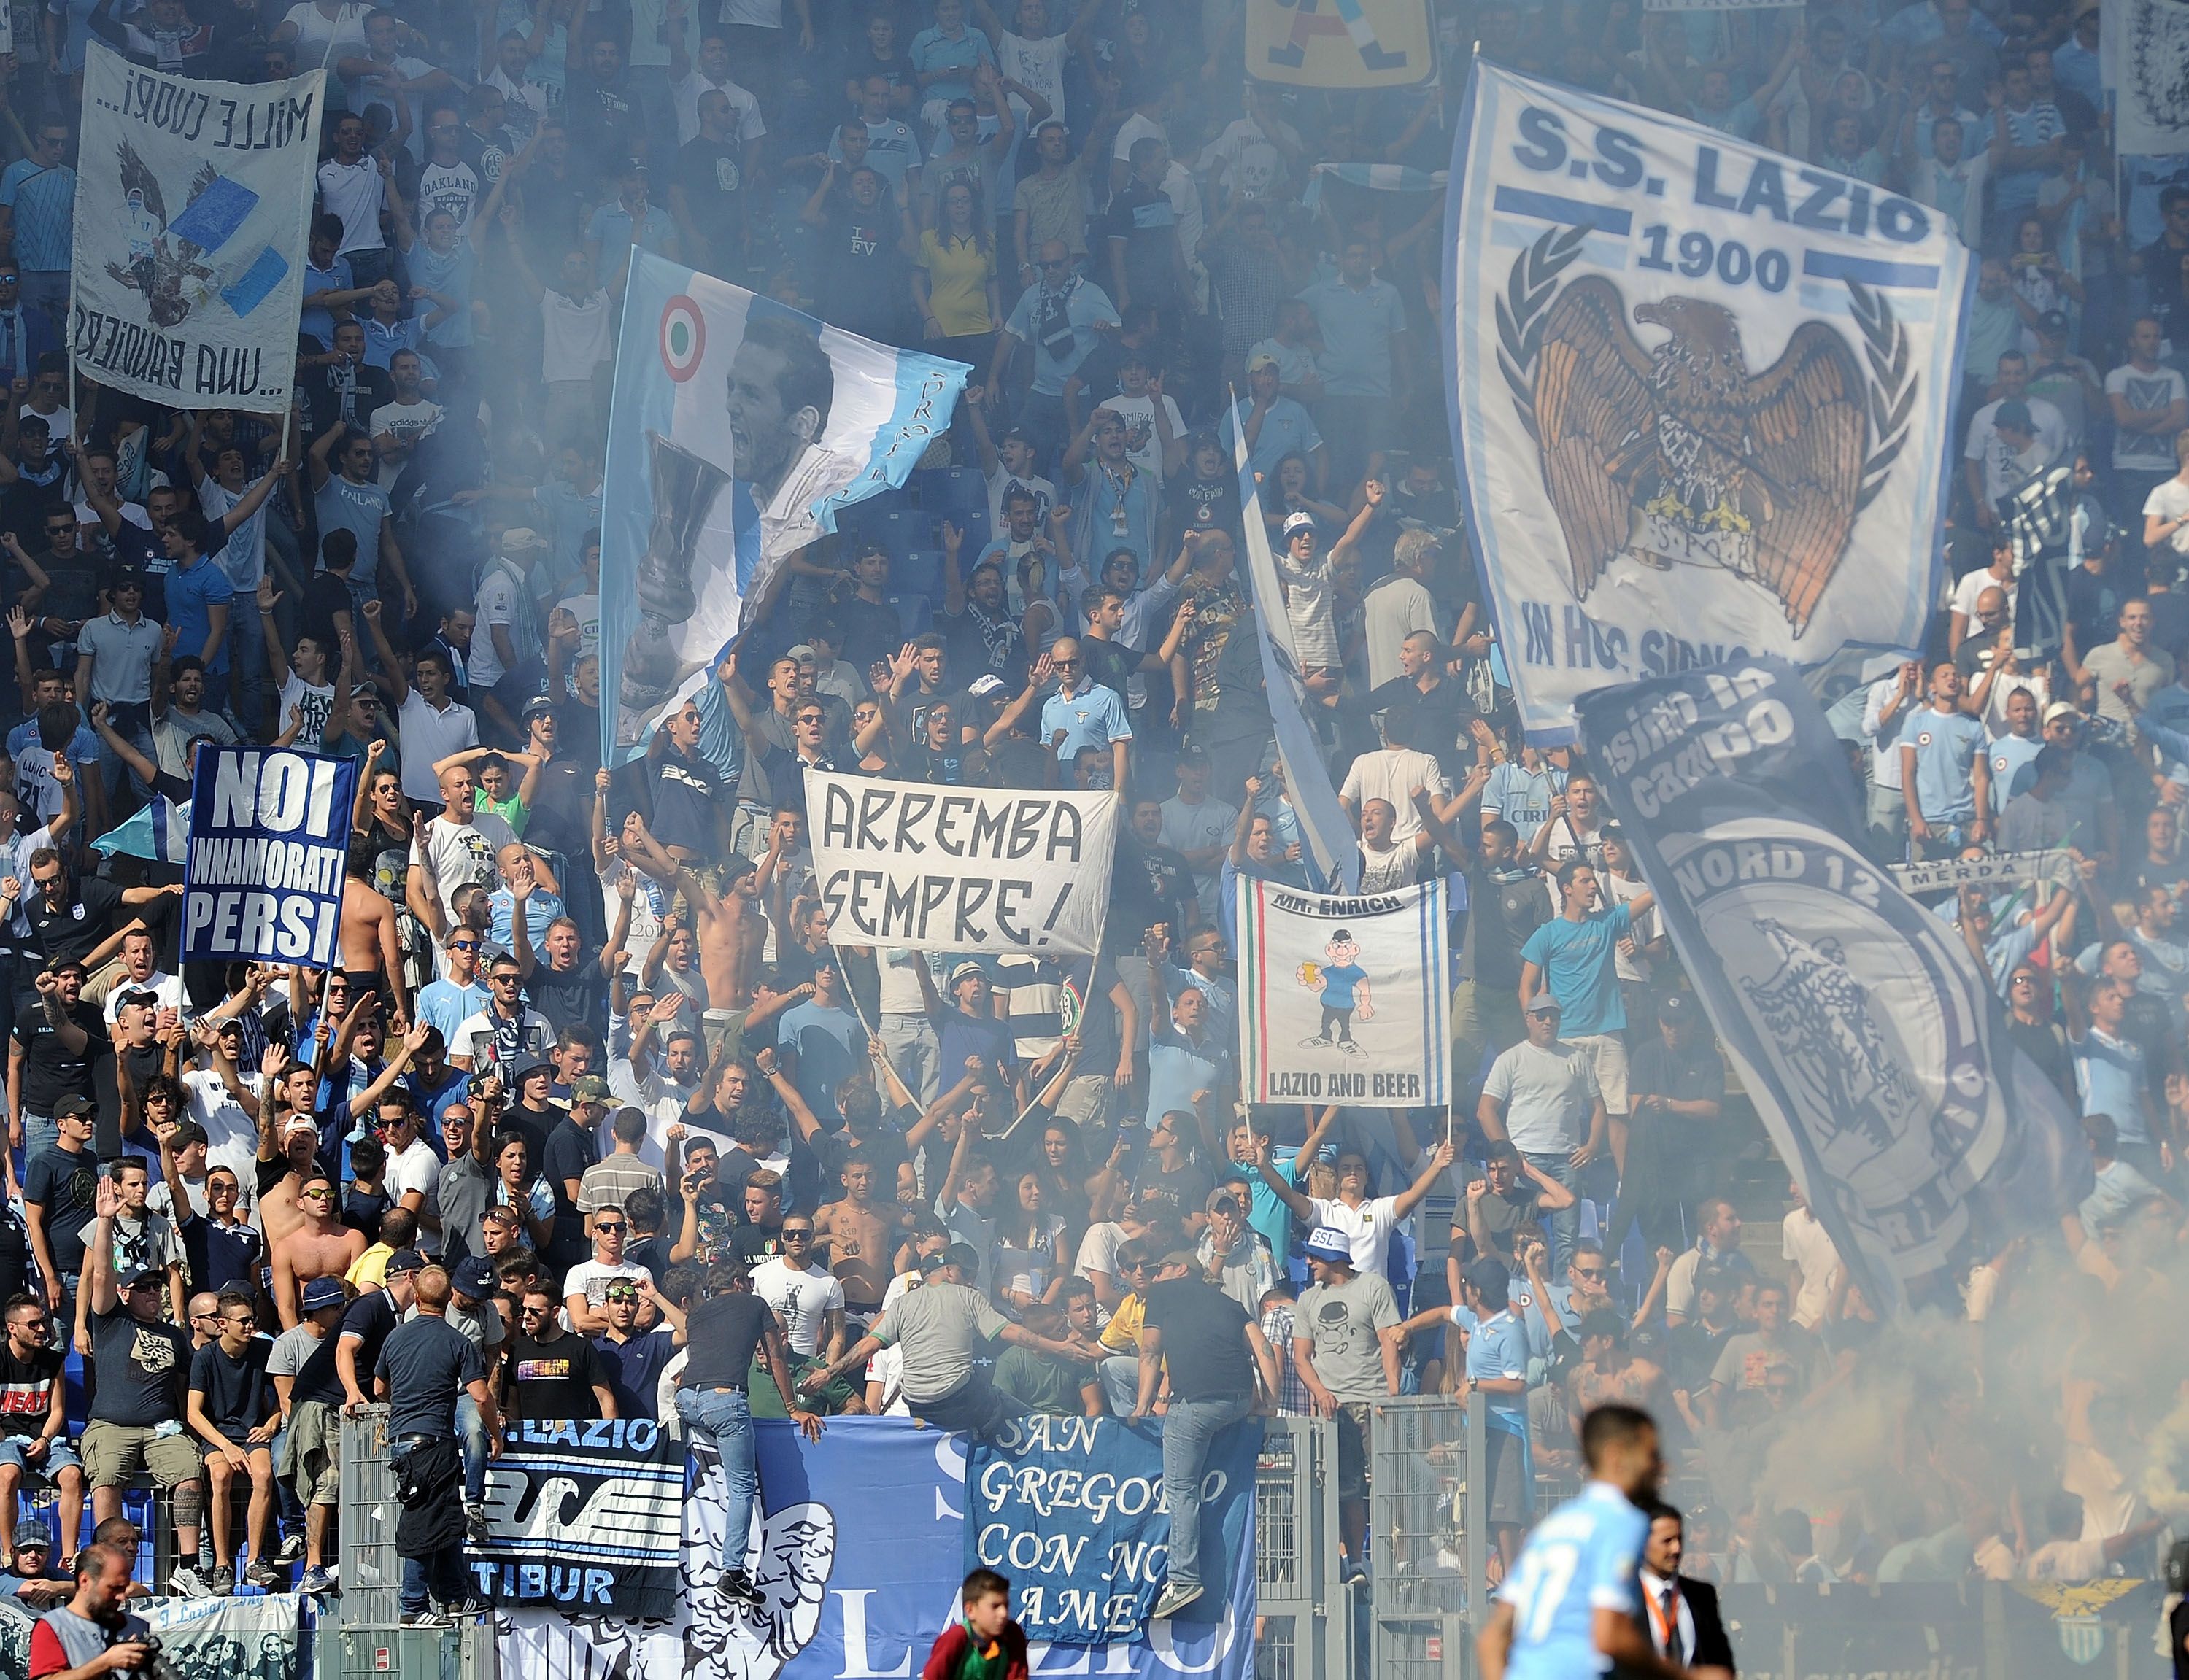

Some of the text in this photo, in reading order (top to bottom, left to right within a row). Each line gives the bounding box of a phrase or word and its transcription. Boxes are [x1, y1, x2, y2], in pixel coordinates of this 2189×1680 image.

[425, 177, 476, 196] OAKLAND
[1512, 105, 1932, 244] S.S. LAZIO
[851, 239, 877, 256] FV
[1637, 225, 1790, 293] 1900
[1121, 412, 1154, 424] DMIRAL
[1521, 601, 1555, 667] IN
[212, 751, 336, 838] NOI
[823, 783, 1081, 862] ARREMBA
[1512, 810, 1548, 823] CIRI
[458, 835, 482, 844] LOST
[470, 851, 497, 862] TRO
[190, 837, 345, 897] INNAMORATI
[1825, 853, 1880, 910] 12
[1912, 864, 2015, 886] MERDA
[1274, 894, 1402, 915] MR. ENRICH
[186, 892, 336, 963] PERSI
[1270, 1072, 1420, 1098] LAZIO AND BEER
[1313, 1231, 1333, 1246] SSL
[995, 1414, 1103, 1456] SAN
[978, 1523, 1169, 1583] CON NO
[470, 1561, 614, 1604] TIBUR
